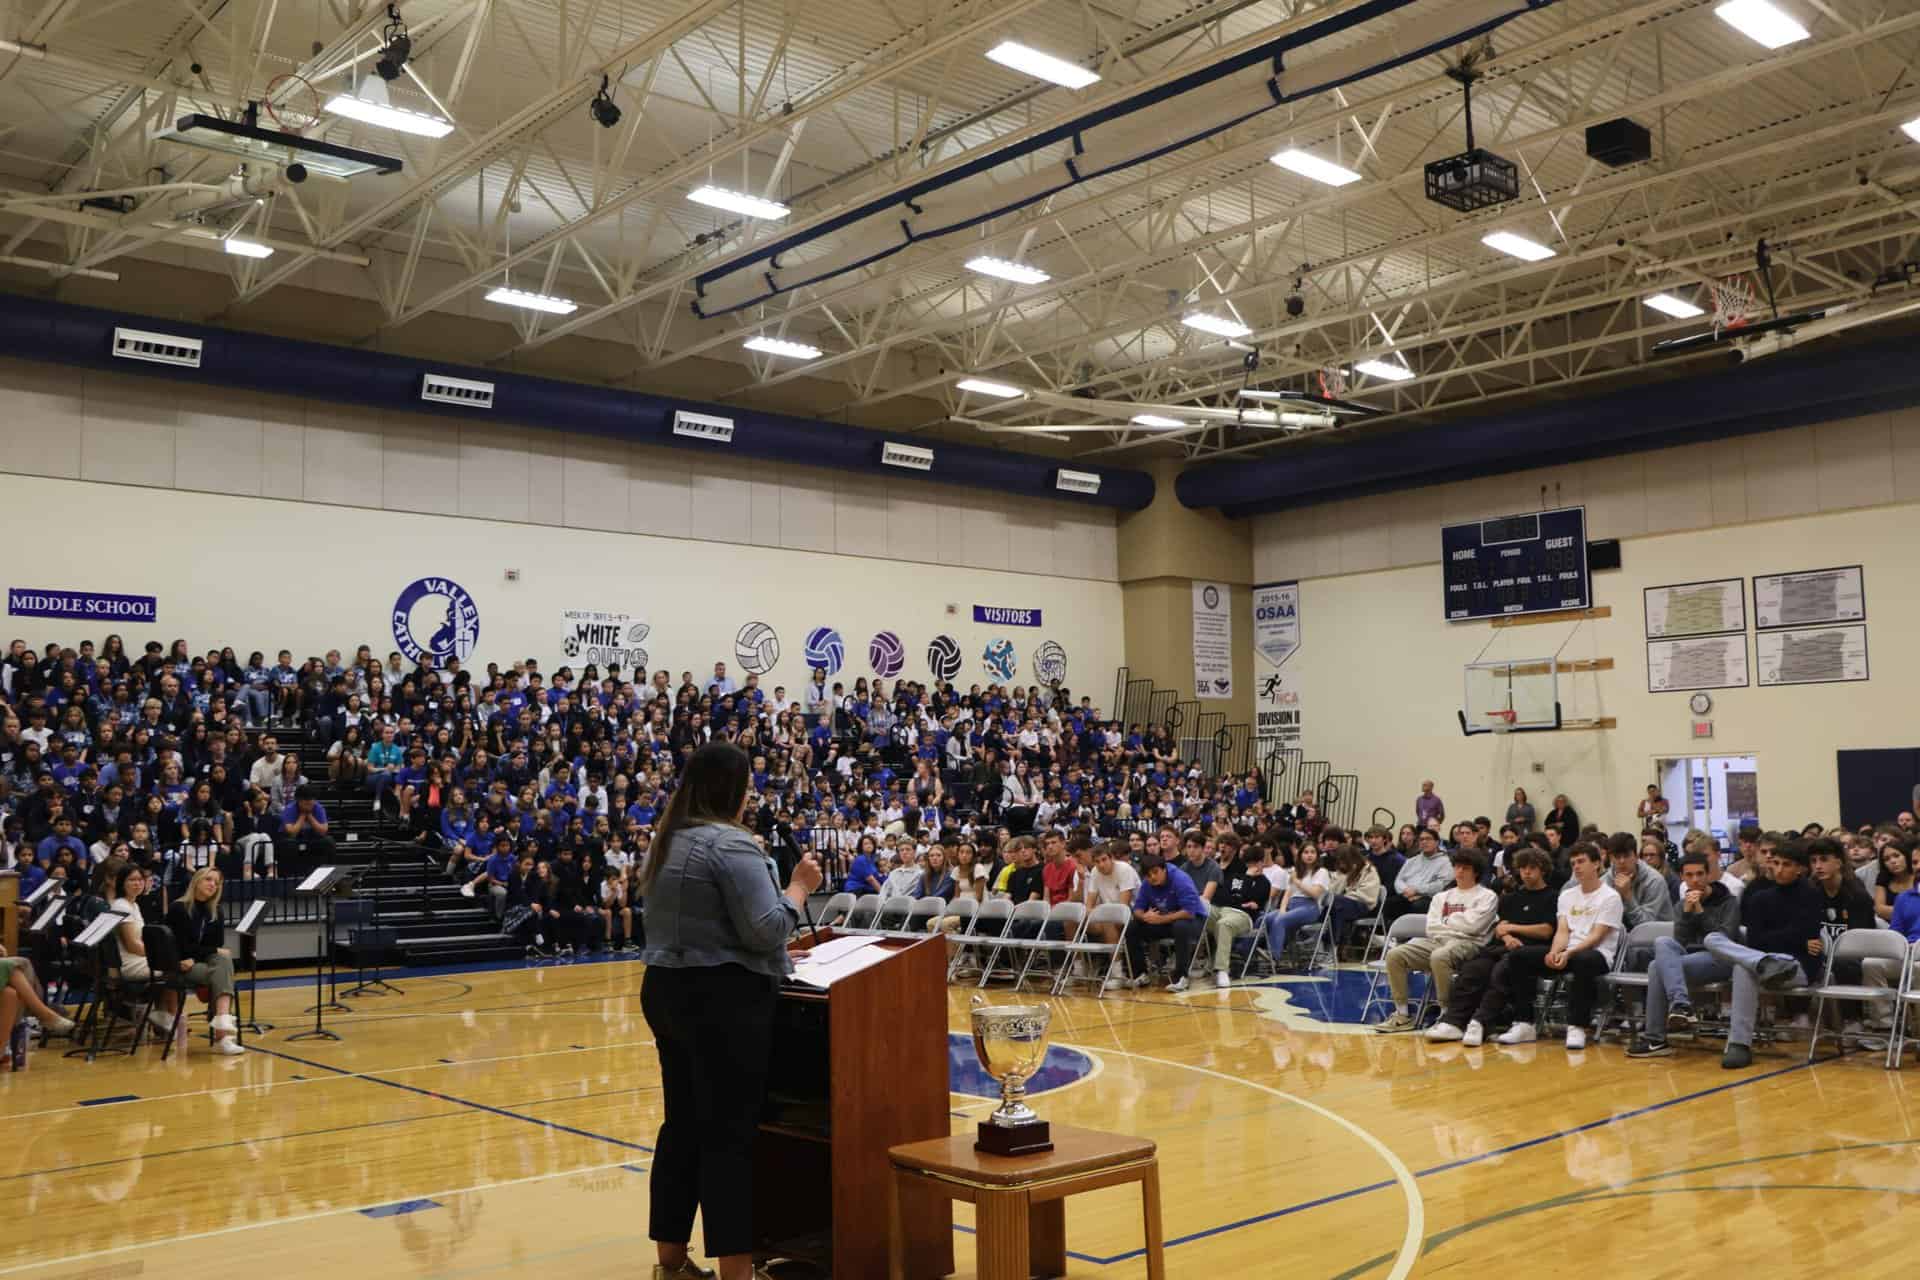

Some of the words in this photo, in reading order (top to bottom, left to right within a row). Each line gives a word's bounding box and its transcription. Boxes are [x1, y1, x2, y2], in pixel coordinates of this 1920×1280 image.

[1545, 537, 1573, 550] GUEST
[1453, 548, 1476, 560] HOME
[11, 595, 82, 611] MIDDLE
[86, 600, 154, 615] SCHOOL
[424, 580, 478, 630] VALLEY
[1256, 605, 1296, 620] OSAA
[984, 607, 1032, 624] VISITORS
[576, 624, 620, 647] WHITE
[1258, 711, 1292, 725] DIVISION
